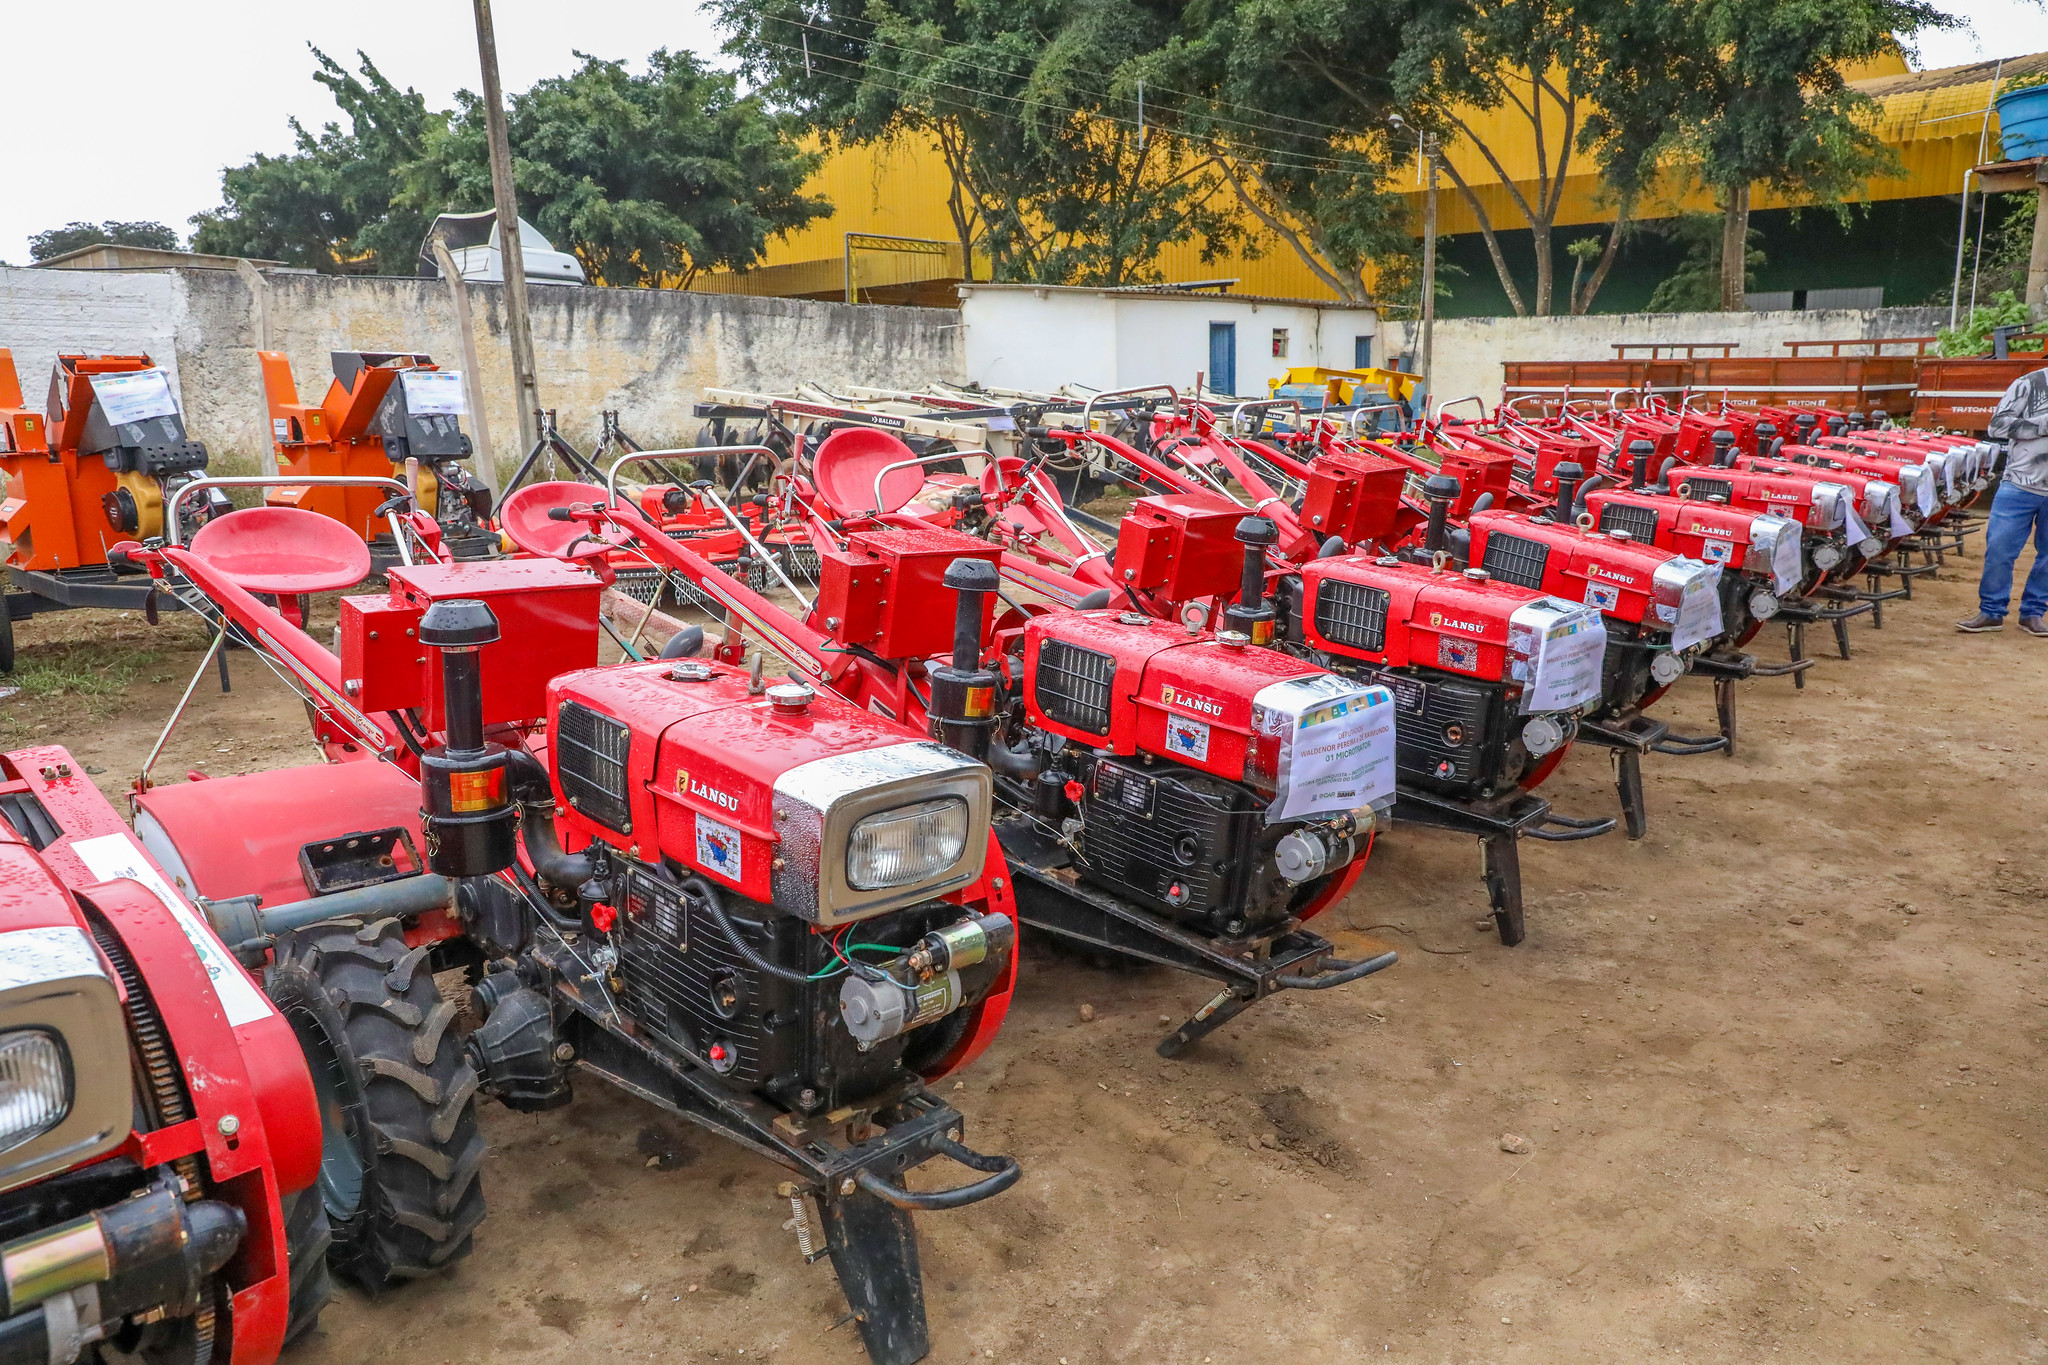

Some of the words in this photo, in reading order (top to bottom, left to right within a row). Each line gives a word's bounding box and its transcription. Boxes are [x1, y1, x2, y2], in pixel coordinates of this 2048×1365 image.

[878, 417, 901, 426] BALDAN
[1771, 493, 1799, 501] LANSU
[1701, 526, 1732, 537] LANSU
[1598, 569, 1635, 585] LANSU
[1443, 618, 1485, 634] LANSU
[1175, 693, 1224, 717] LANSU
[1300, 744, 1336, 758] WALDENOR
[1336, 737, 1357, 750] PEREIRA
[1365, 725, 1390, 738] RAIMUNDO
[1325, 754, 1335, 763] 01
[1335, 740, 1372, 761] MICROTRATOR
[690, 779, 740, 812] LANSU
